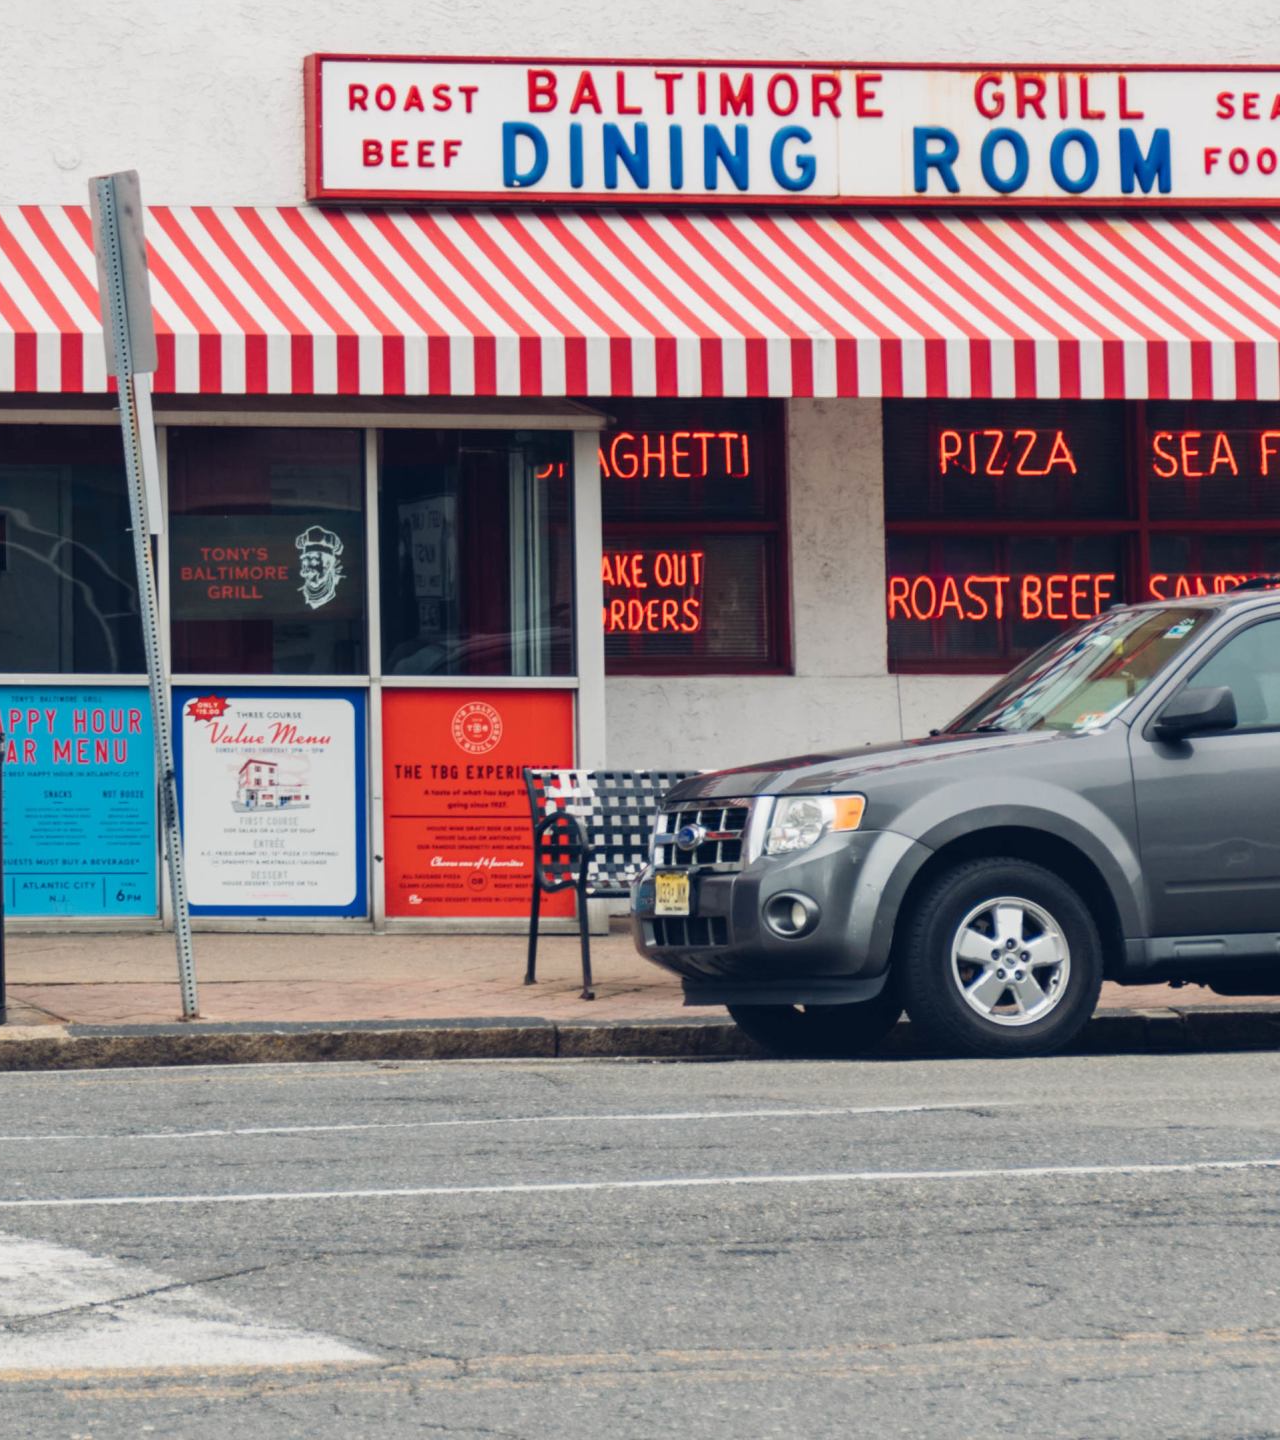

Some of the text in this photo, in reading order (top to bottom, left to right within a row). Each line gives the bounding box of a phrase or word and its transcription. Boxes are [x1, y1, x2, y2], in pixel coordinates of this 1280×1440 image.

[349, 83, 481, 115] ROAST
[526, 69, 1145, 121] BALTIMORE GRILL
[362, 139, 463, 169] BEEF
[502, 121, 1173, 195] DINING ROOM
[536, 431, 749, 479] GHETTI
[939, 429, 1077, 477] PIZZA
[1151, 429, 1239, 477] SEA
[200, 547, 268, 561] TONY'S
[181, 566, 289, 580] BALTIMORE
[601, 552, 704, 588] AKE OUT
[207, 586, 263, 599] GRILL
[887, 574, 1115, 620] ROAST BEEF
[602, 597, 699, 632] RDERS
[73, 708, 142, 734] HOUR
[204, 722, 331, 745] Value Menu
[6, 738, 128, 764] AR MENU
[395, 764, 423, 779] THE
[431, 764, 458, 779] TBG
[22, 881, 96, 889] ATLANTIC CITY
